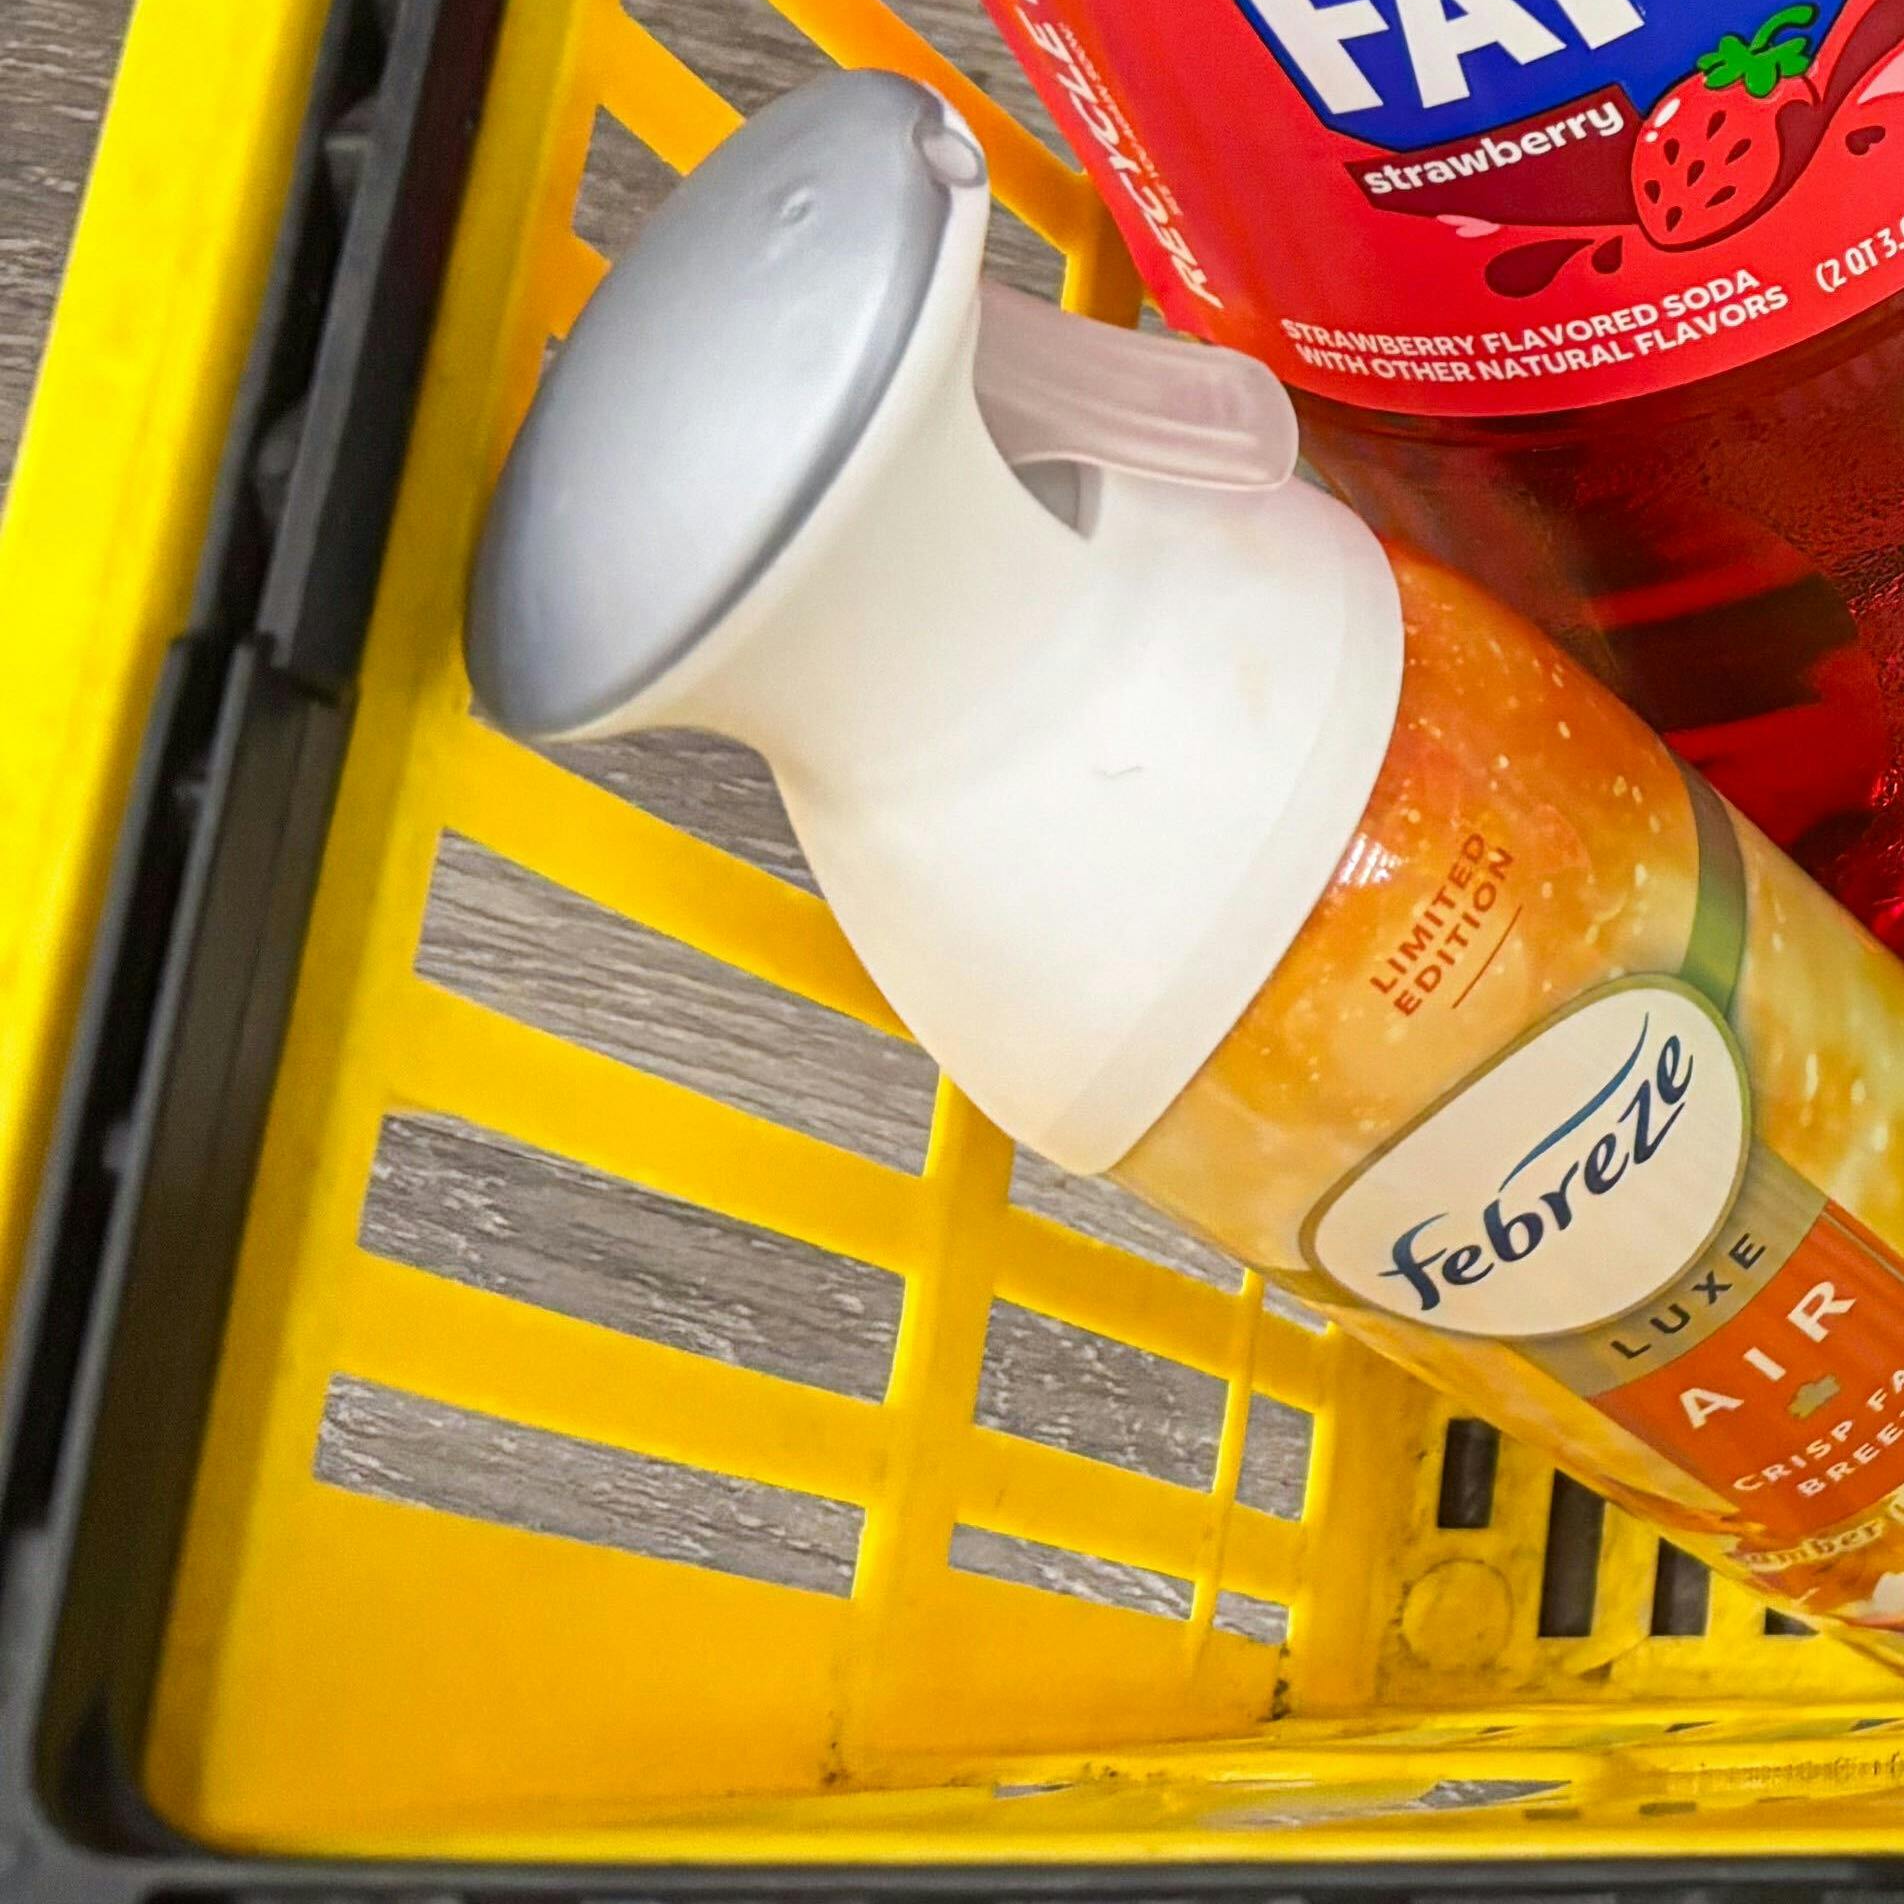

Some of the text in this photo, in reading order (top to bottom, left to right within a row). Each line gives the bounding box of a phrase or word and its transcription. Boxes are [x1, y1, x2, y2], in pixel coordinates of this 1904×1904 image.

[1012, 4, 1225, 310] RECYCLE
[1363, 98, 1626, 198] strawberry
[1279, 267, 1762, 360] STRAWBERRY FLAVORED SODA
[1812, 254, 1848, 296] (2
[1845, 236, 1880, 276] QT
[1295, 283, 1790, 386] WITH OTHER NATURAL FLAVORS
[1369, 832, 1486, 995] LIMITED
[1393, 847, 1514, 1017] EDITION
[1377, 1011, 1695, 1312] febreze
[1609, 1231, 1768, 1360] LUXE
[1678, 1279, 1858, 1431] AIR
[1732, 1419, 1854, 1493] CRISP
